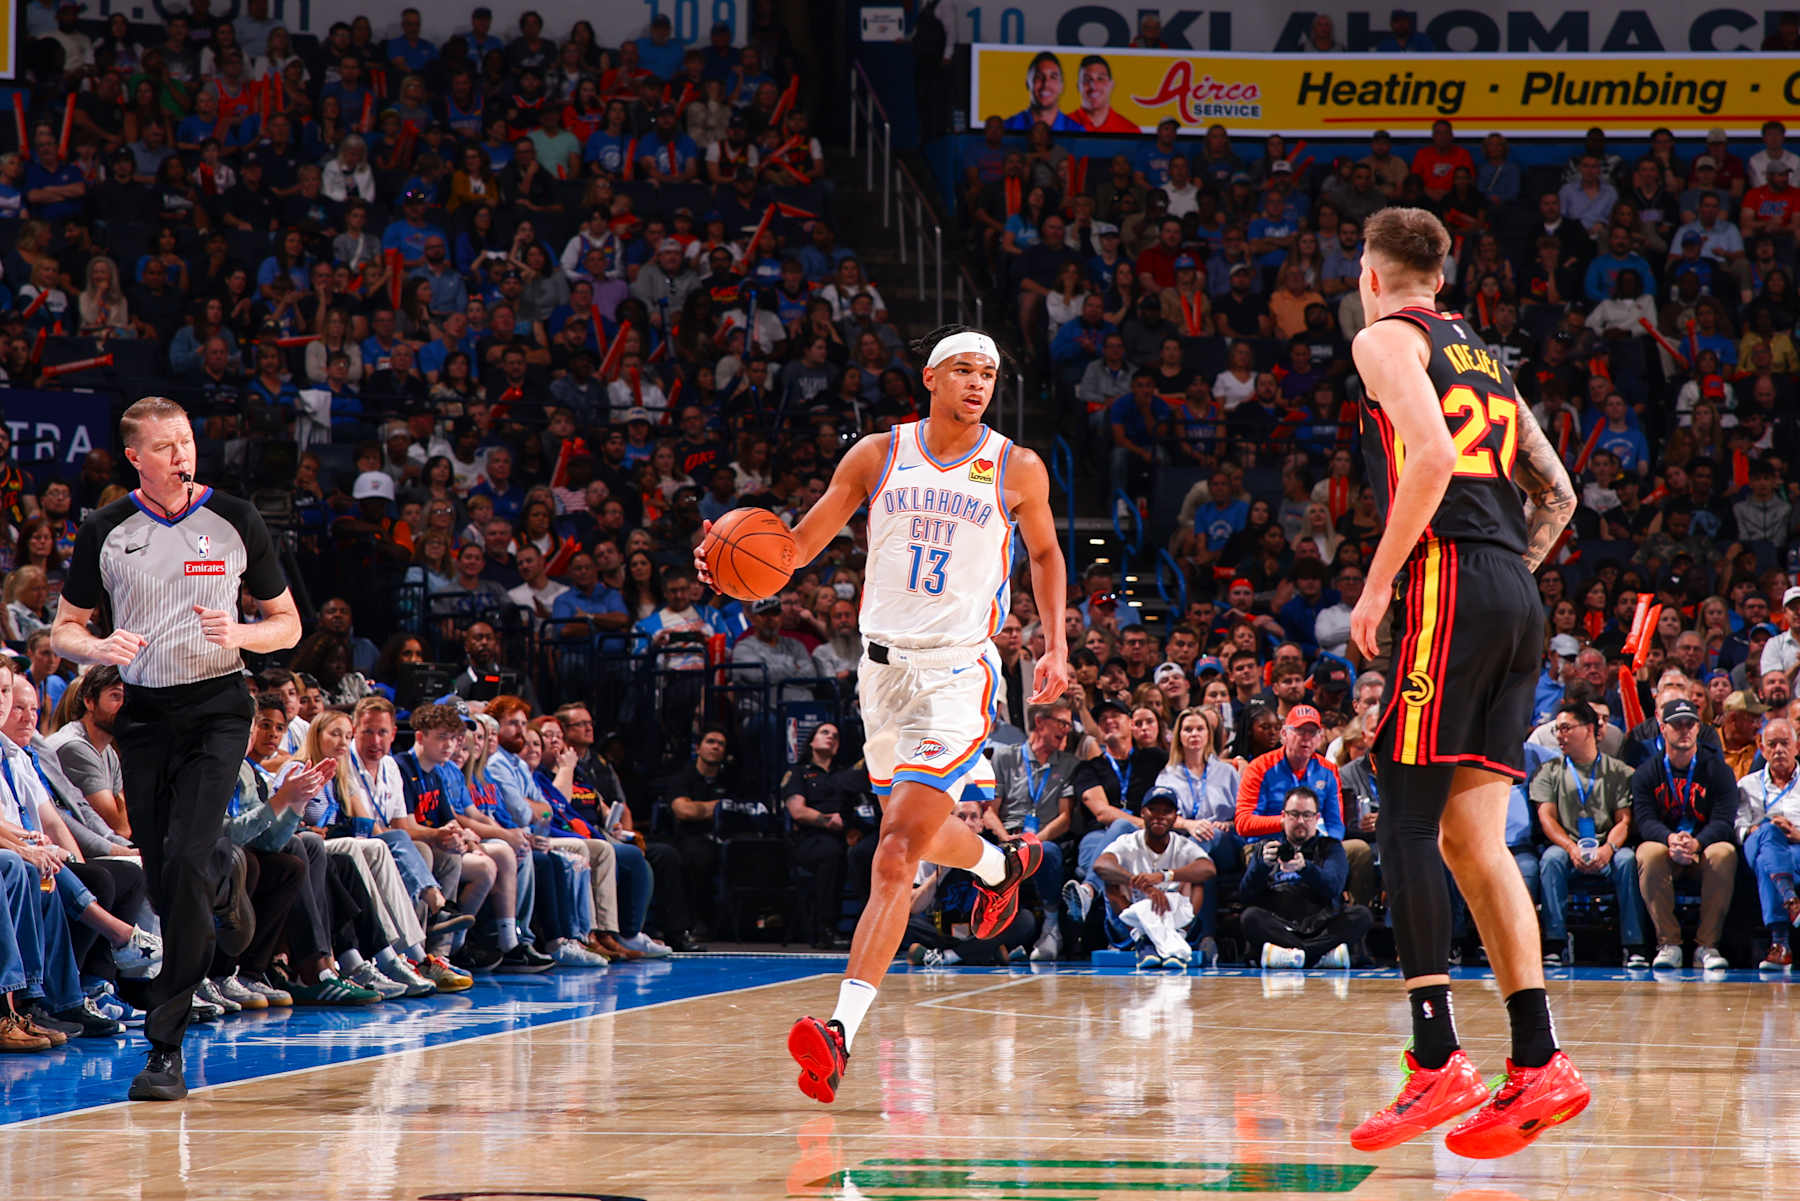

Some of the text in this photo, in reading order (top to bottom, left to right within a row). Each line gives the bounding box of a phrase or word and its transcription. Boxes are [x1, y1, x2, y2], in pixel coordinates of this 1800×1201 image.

[1131, 60, 1258, 123] Airco
[1193, 104, 1261, 117] SERVICE
[1297, 72, 1466, 114] Heating
[1521, 72, 1726, 114] Plumbing
[1441, 384, 1519, 480] 27
[884, 487, 993, 528] OKLAHOMA
[910, 516, 958, 546] CITY
[185, 564, 225, 574] Emirates
[907, 542, 952, 597] 13
